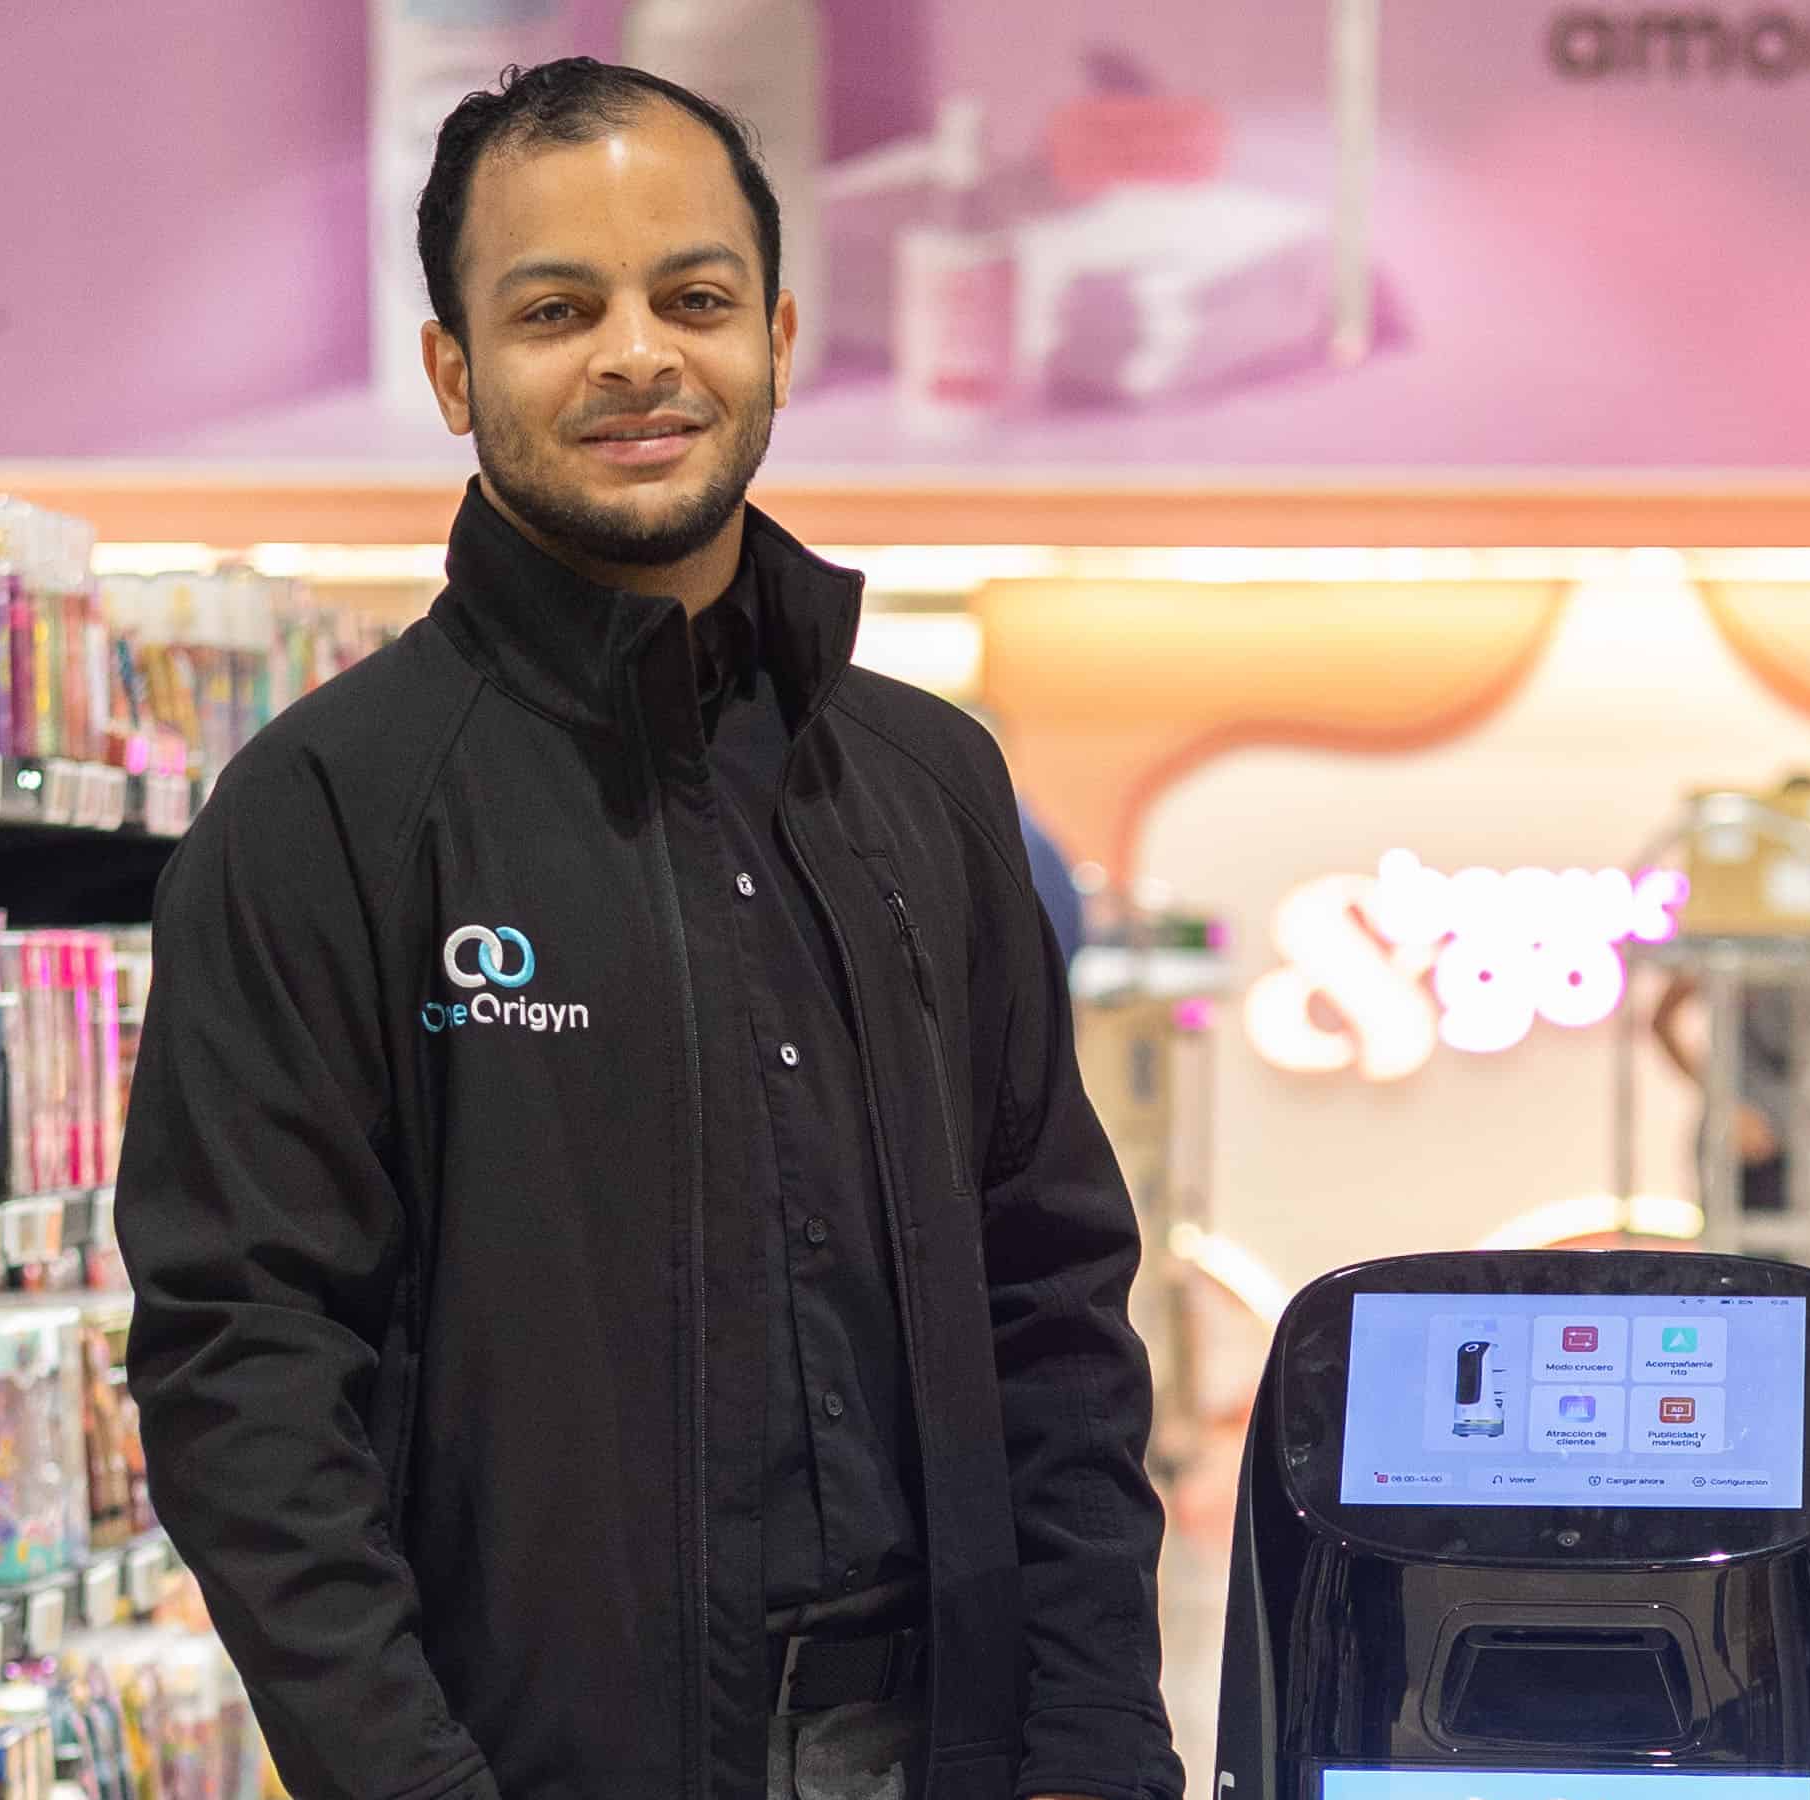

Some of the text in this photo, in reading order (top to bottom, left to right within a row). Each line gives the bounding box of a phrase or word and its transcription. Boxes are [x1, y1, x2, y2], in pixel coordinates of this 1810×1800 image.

[1546, 1363, 1613, 1372] Modo crucero
[1648, 1430, 1697, 1440] Publicidad
[1556, 1438, 1595, 1447] clientes
[1652, 1439, 1701, 1449] marketing
[1606, 1476, 1665, 1486] Cargar ahora
